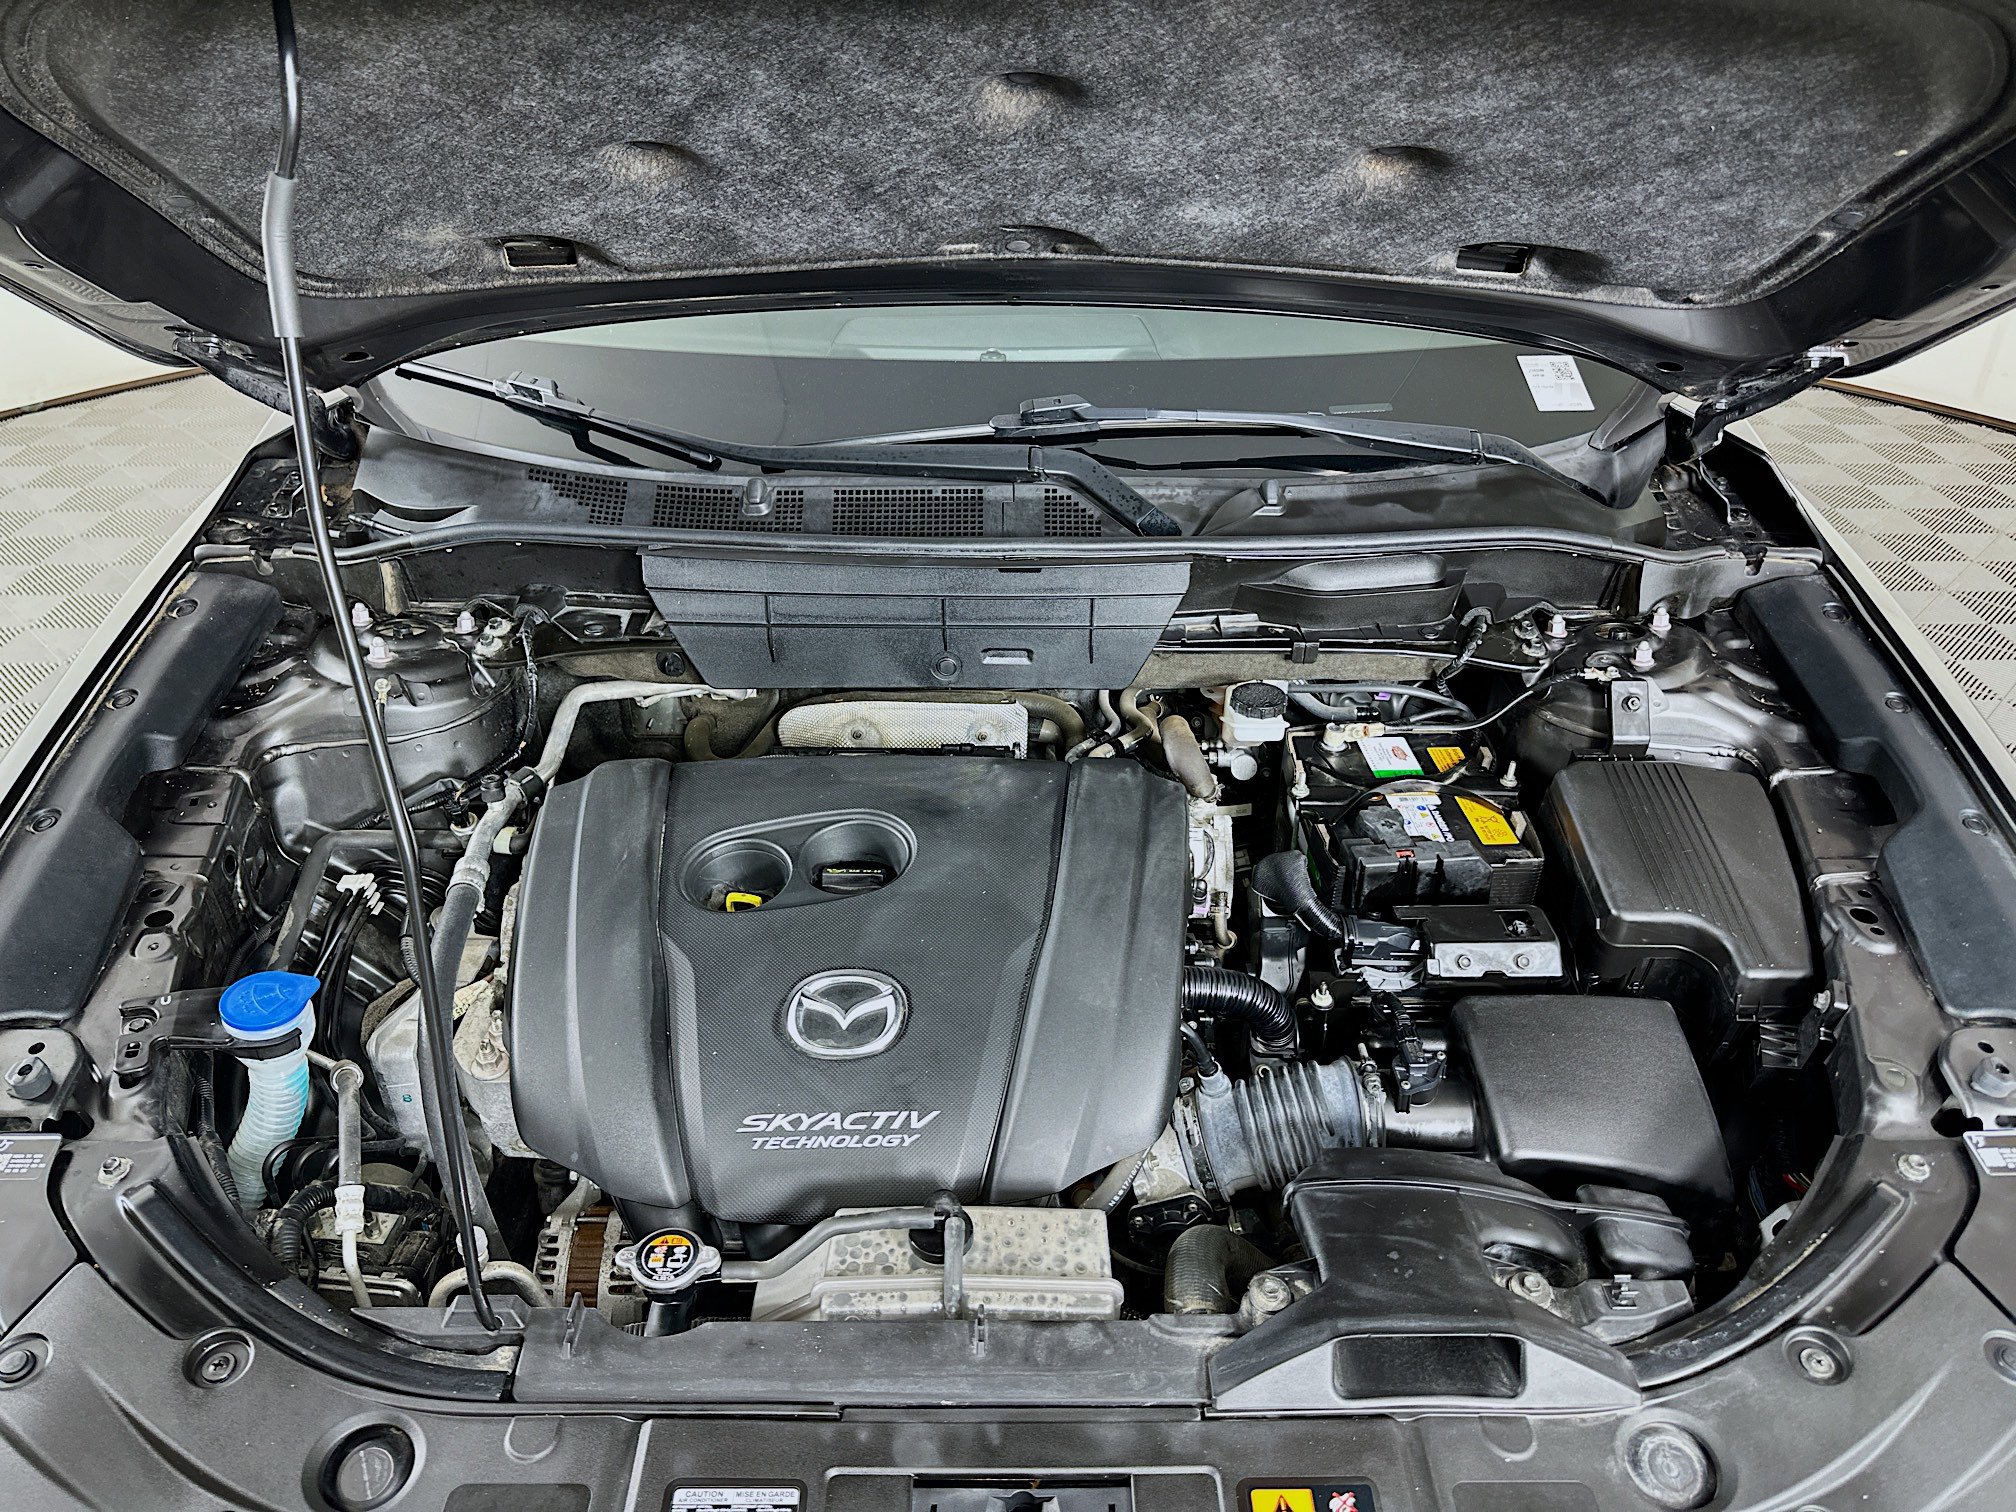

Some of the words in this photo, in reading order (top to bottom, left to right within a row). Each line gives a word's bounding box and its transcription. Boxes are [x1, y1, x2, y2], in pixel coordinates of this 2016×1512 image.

[736, 1110, 941, 1132] SKYACTIV
[752, 1134, 921, 1149] TECHNOLOGY
[685, 1490, 724, 1498] CAUTION
